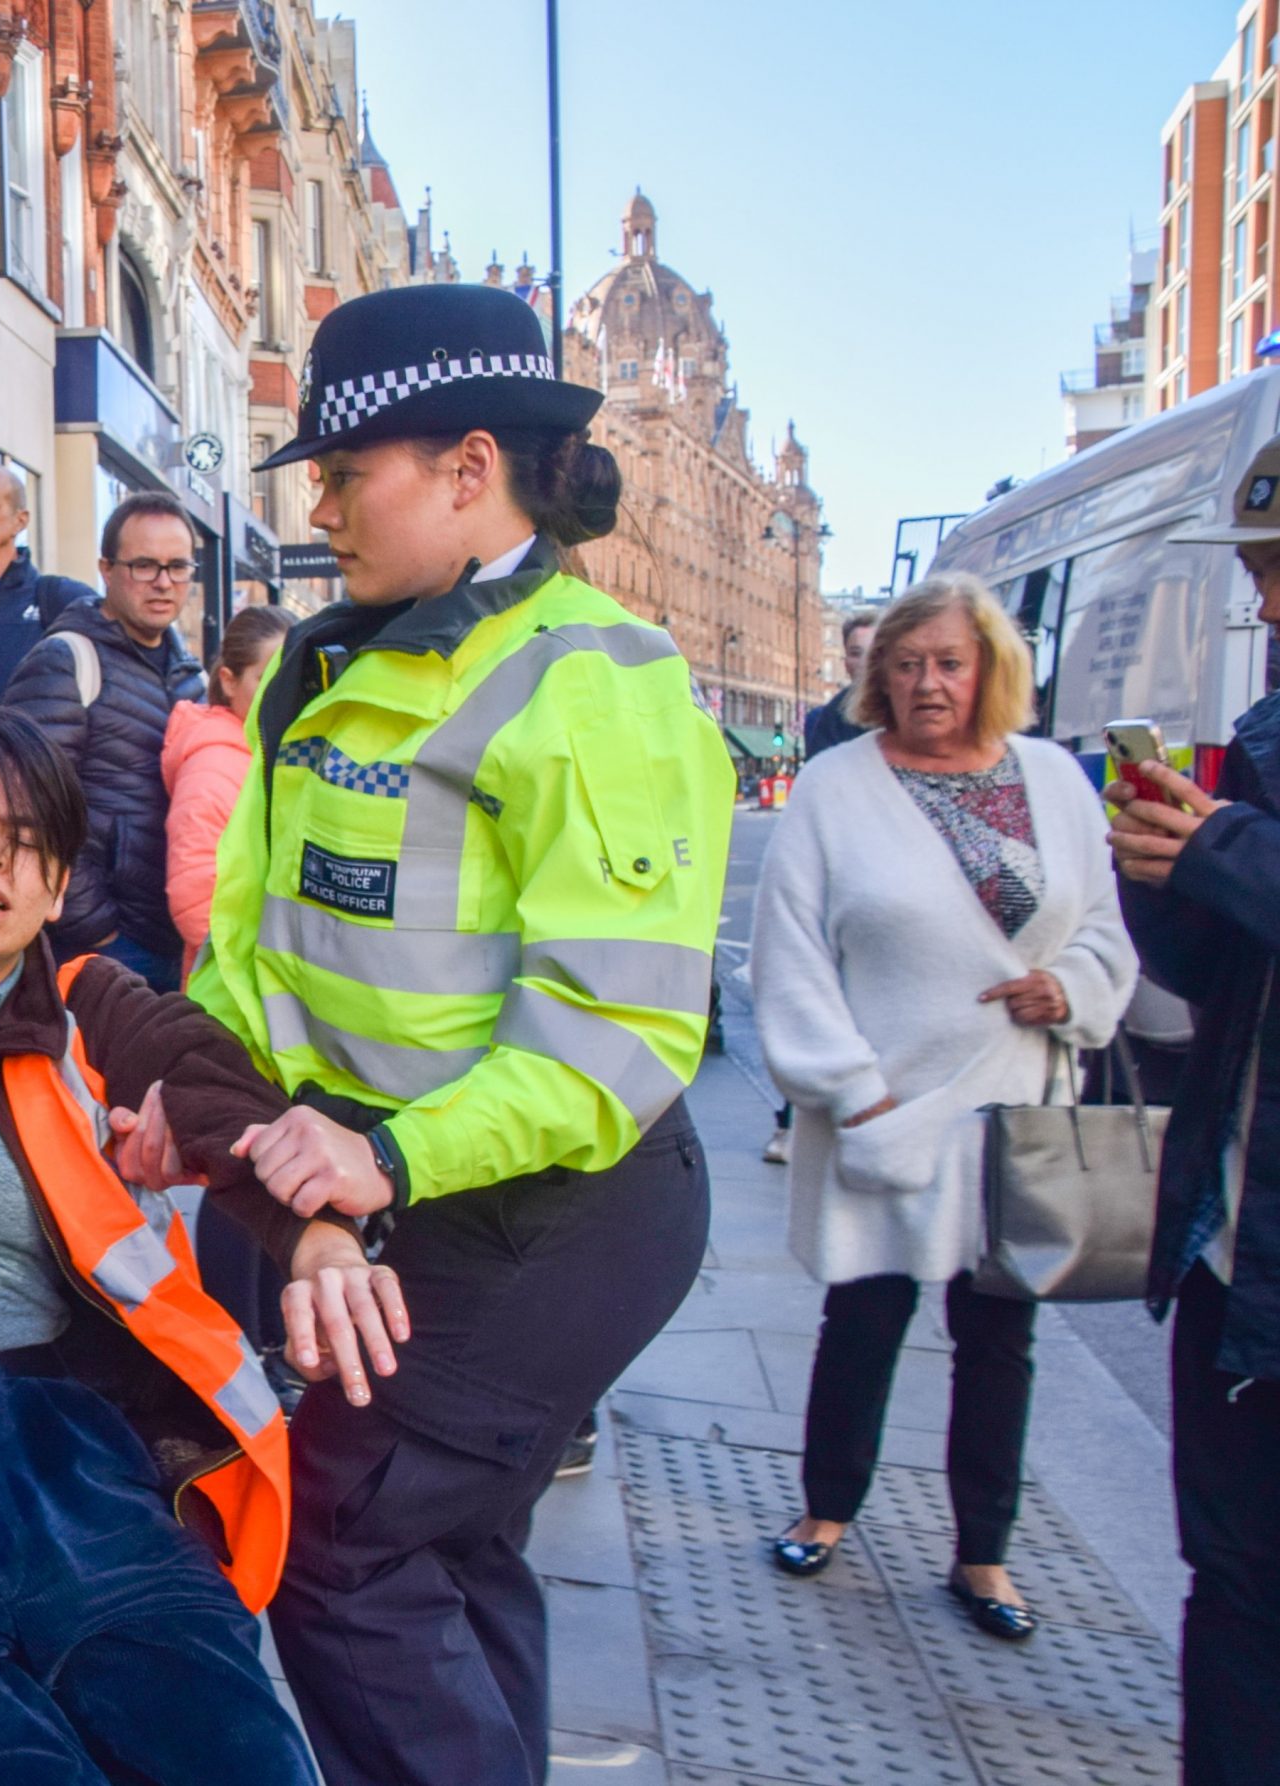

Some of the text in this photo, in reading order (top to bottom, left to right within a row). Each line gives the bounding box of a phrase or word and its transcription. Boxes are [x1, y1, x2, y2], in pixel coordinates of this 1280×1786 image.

[325, 861, 382, 877] METROPOLITAN
[331, 872, 371, 889] POLICE
[304, 878, 387, 911] POLICE OFFICER
